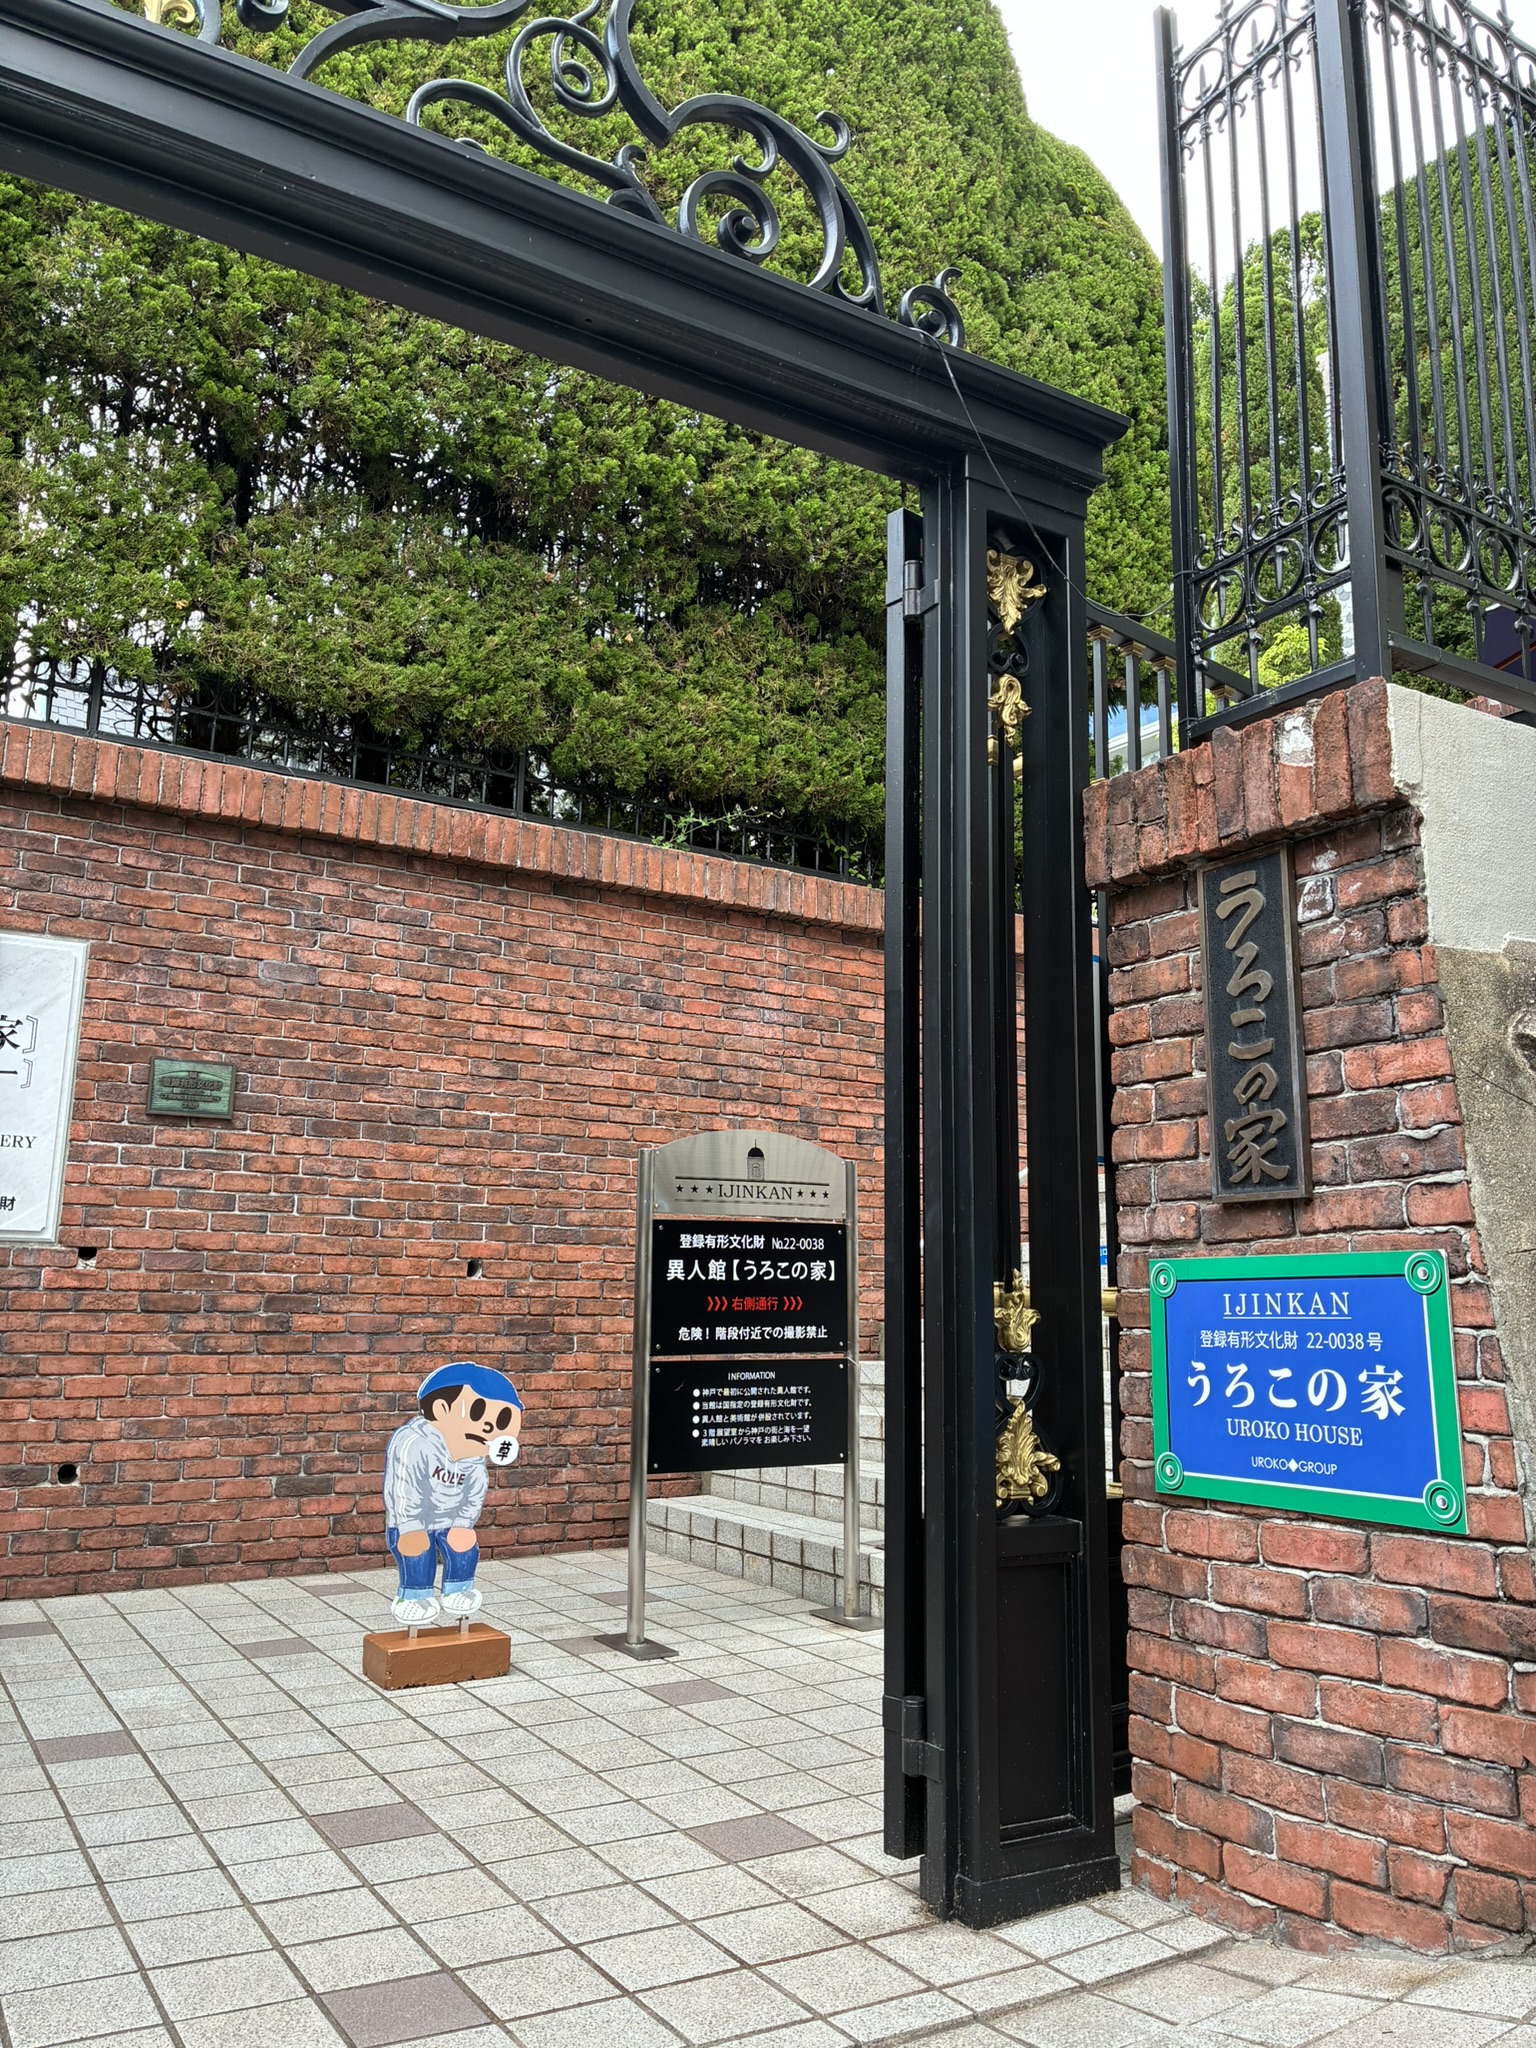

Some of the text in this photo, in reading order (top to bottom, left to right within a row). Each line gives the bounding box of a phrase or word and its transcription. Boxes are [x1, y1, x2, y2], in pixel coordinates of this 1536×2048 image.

[1215, 869, 1291, 1183] うろこの家
[718, 1184, 793, 1200] IJINKAN
[679, 1233, 765, 1249] 登録有形文化財
[731, 1297, 779, 1312] 右側通行
[1223, 1292, 1350, 1316] IJINKAN
[1200, 1330, 1298, 1350] 登録有形文化財
[727, 1371, 776, 1381] INFORMATION
[1187, 1360, 1406, 1421] うろこの家
[1226, 1418, 1364, 1447] UROKO HOUSE
[496, 1440, 512, 1461] 草
[432, 1465, 466, 1486] KOBE
